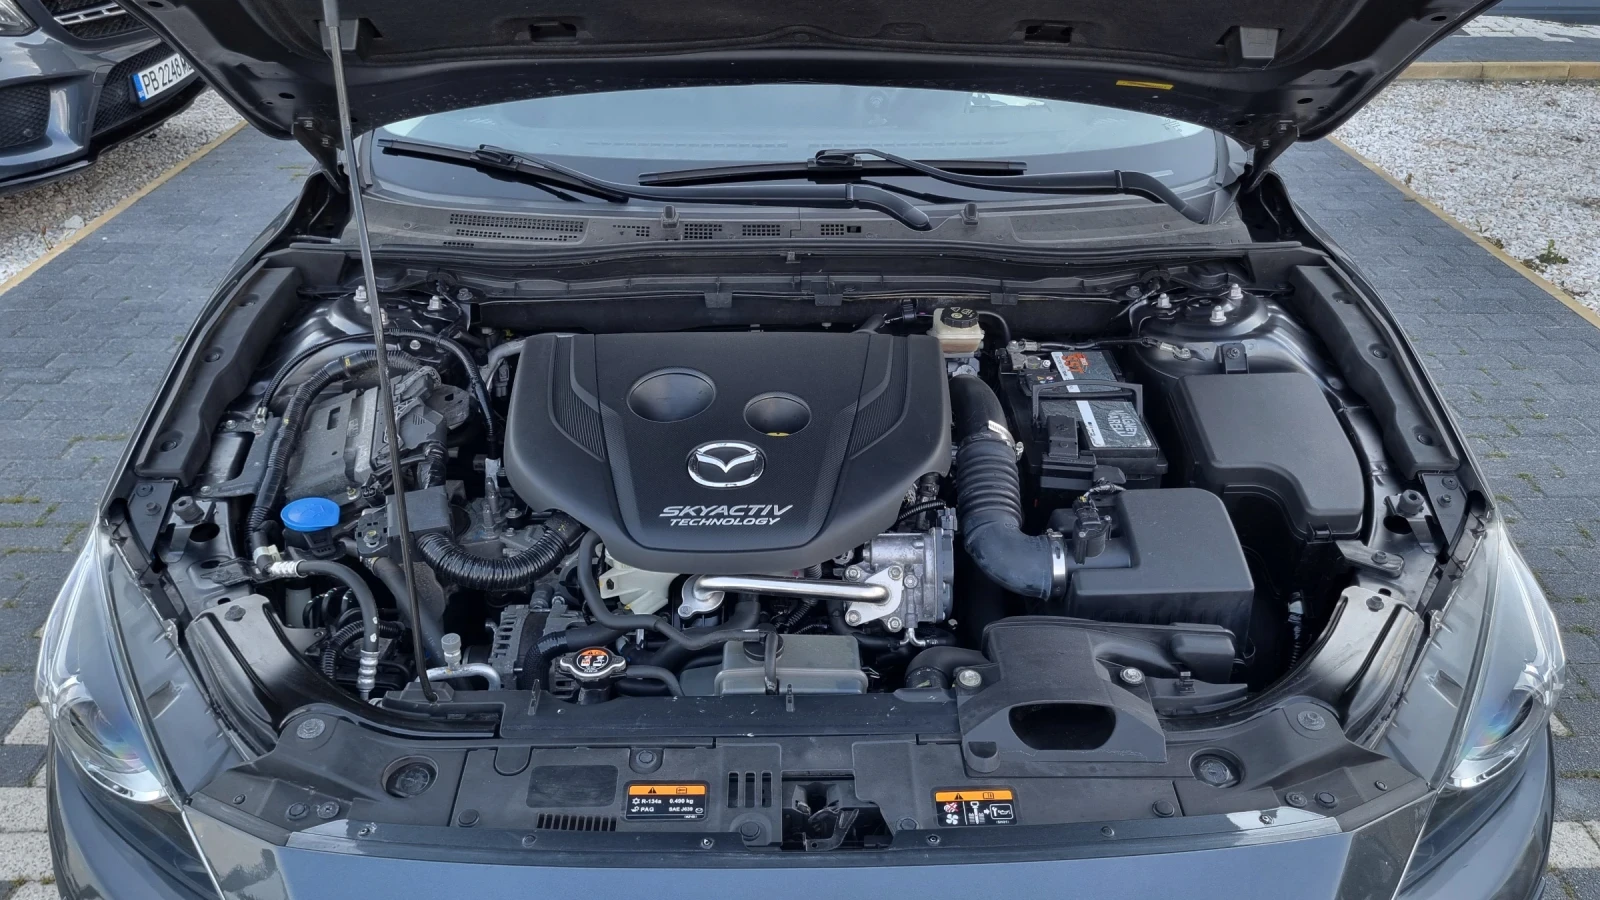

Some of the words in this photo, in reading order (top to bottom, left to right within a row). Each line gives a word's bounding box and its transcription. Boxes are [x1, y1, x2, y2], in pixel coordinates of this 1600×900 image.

[141, 71, 159, 95] PB
[158, 58, 182, 87] 2248
[659, 504, 793, 517] SKYACTIV
[669, 517, 781, 526] TECHNOLOGY
